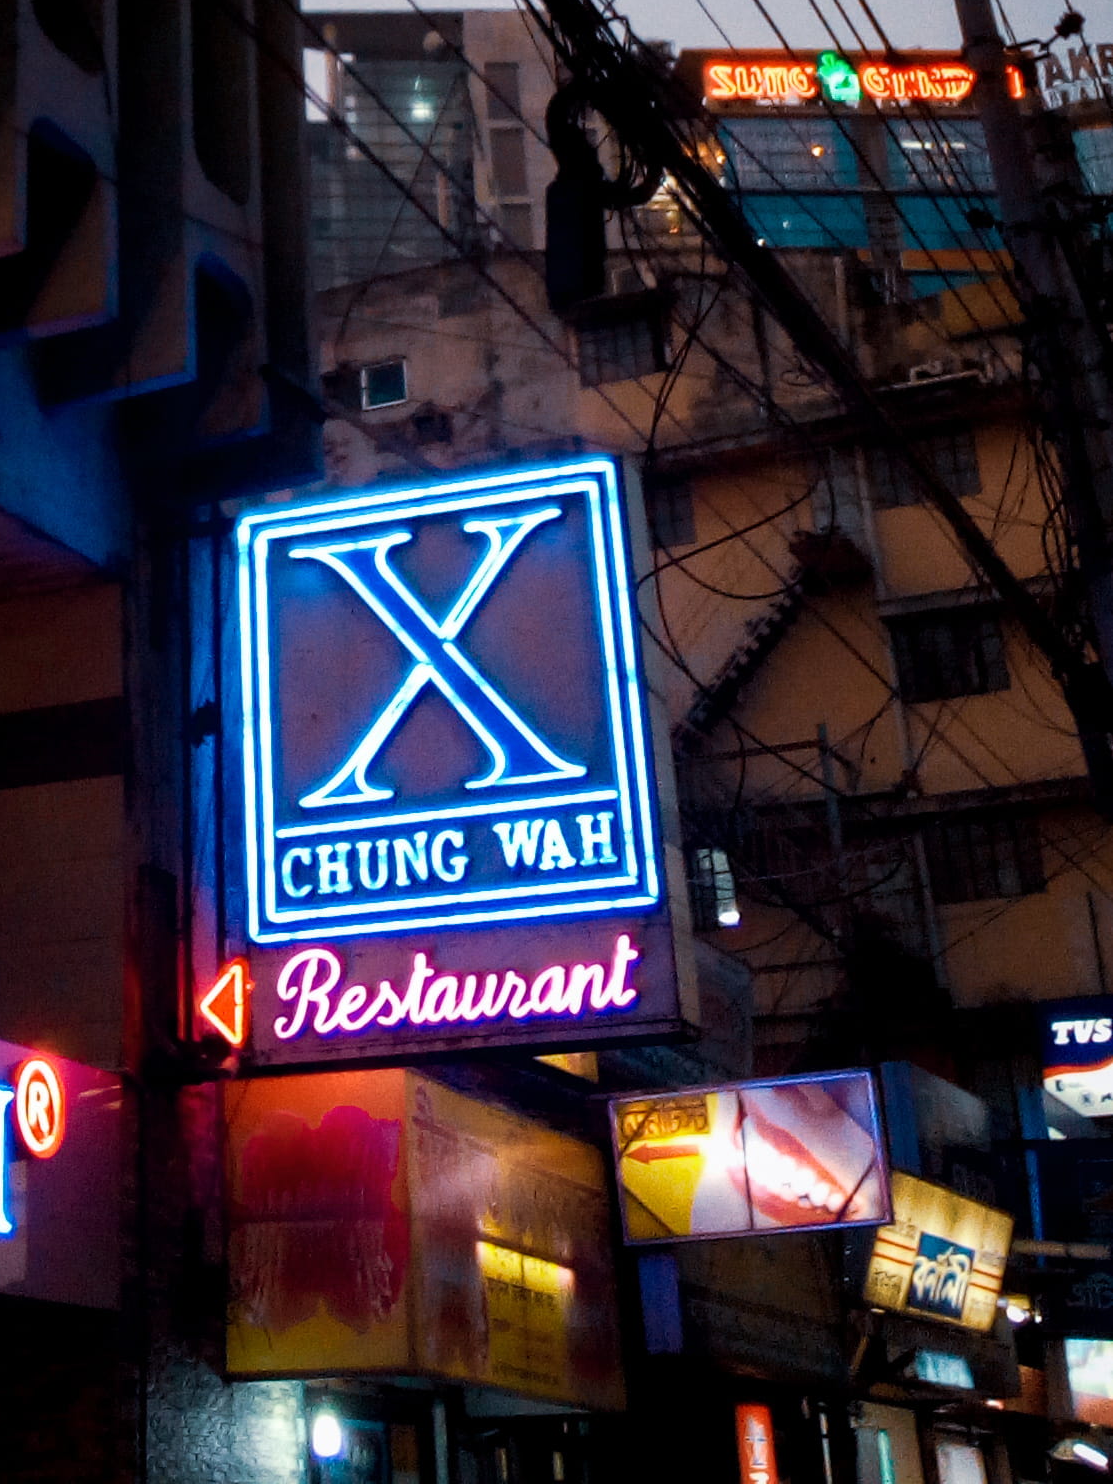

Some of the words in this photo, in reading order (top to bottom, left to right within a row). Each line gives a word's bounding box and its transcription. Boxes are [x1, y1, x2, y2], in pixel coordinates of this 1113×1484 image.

[288, 506, 588, 808] X
[280, 828, 469, 898] CHUNG
[492, 811, 619, 872] WAH
[274, 934, 638, 1040] Restaurant
[1051, 1018, 1113, 1046] TVS
